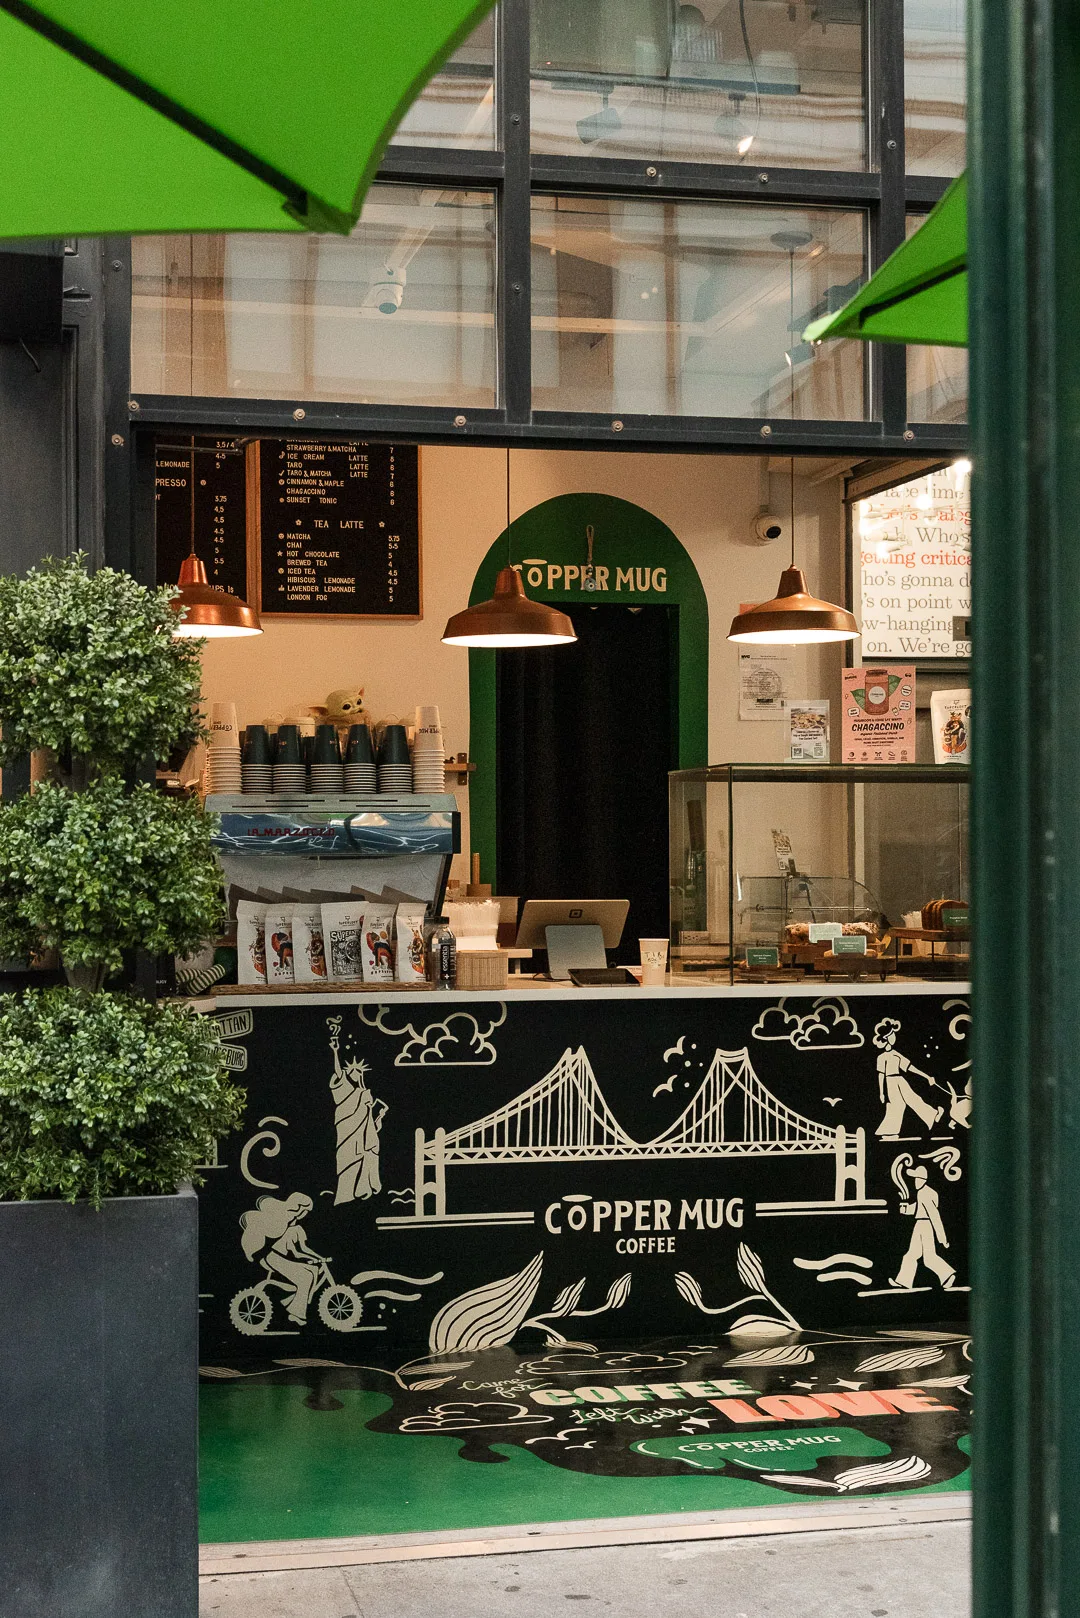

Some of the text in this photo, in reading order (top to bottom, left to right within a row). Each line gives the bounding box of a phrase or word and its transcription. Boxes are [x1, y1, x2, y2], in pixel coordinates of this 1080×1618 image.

[314, 520, 364, 529] TEA LATTE
[616, 567, 667, 592] MUG
[901, 574, 954, 590] gonna
[880, 597, 901, 608] on
[907, 594, 952, 612] point
[861, 615, 953, 634] w-hangin
[867, 641, 892, 652] on.
[898, 637, 950, 653] We're
[852, 723, 904, 731] CHAGACCINO
[545, 1194, 744, 1234] COPPER MUG
[615, 1236, 675, 1254] COFFEE
[529, 1379, 761, 1406] COFFEE
[707, 1389, 959, 1424] LOVE
[678, 1435, 842, 1452] COPPER MUG
